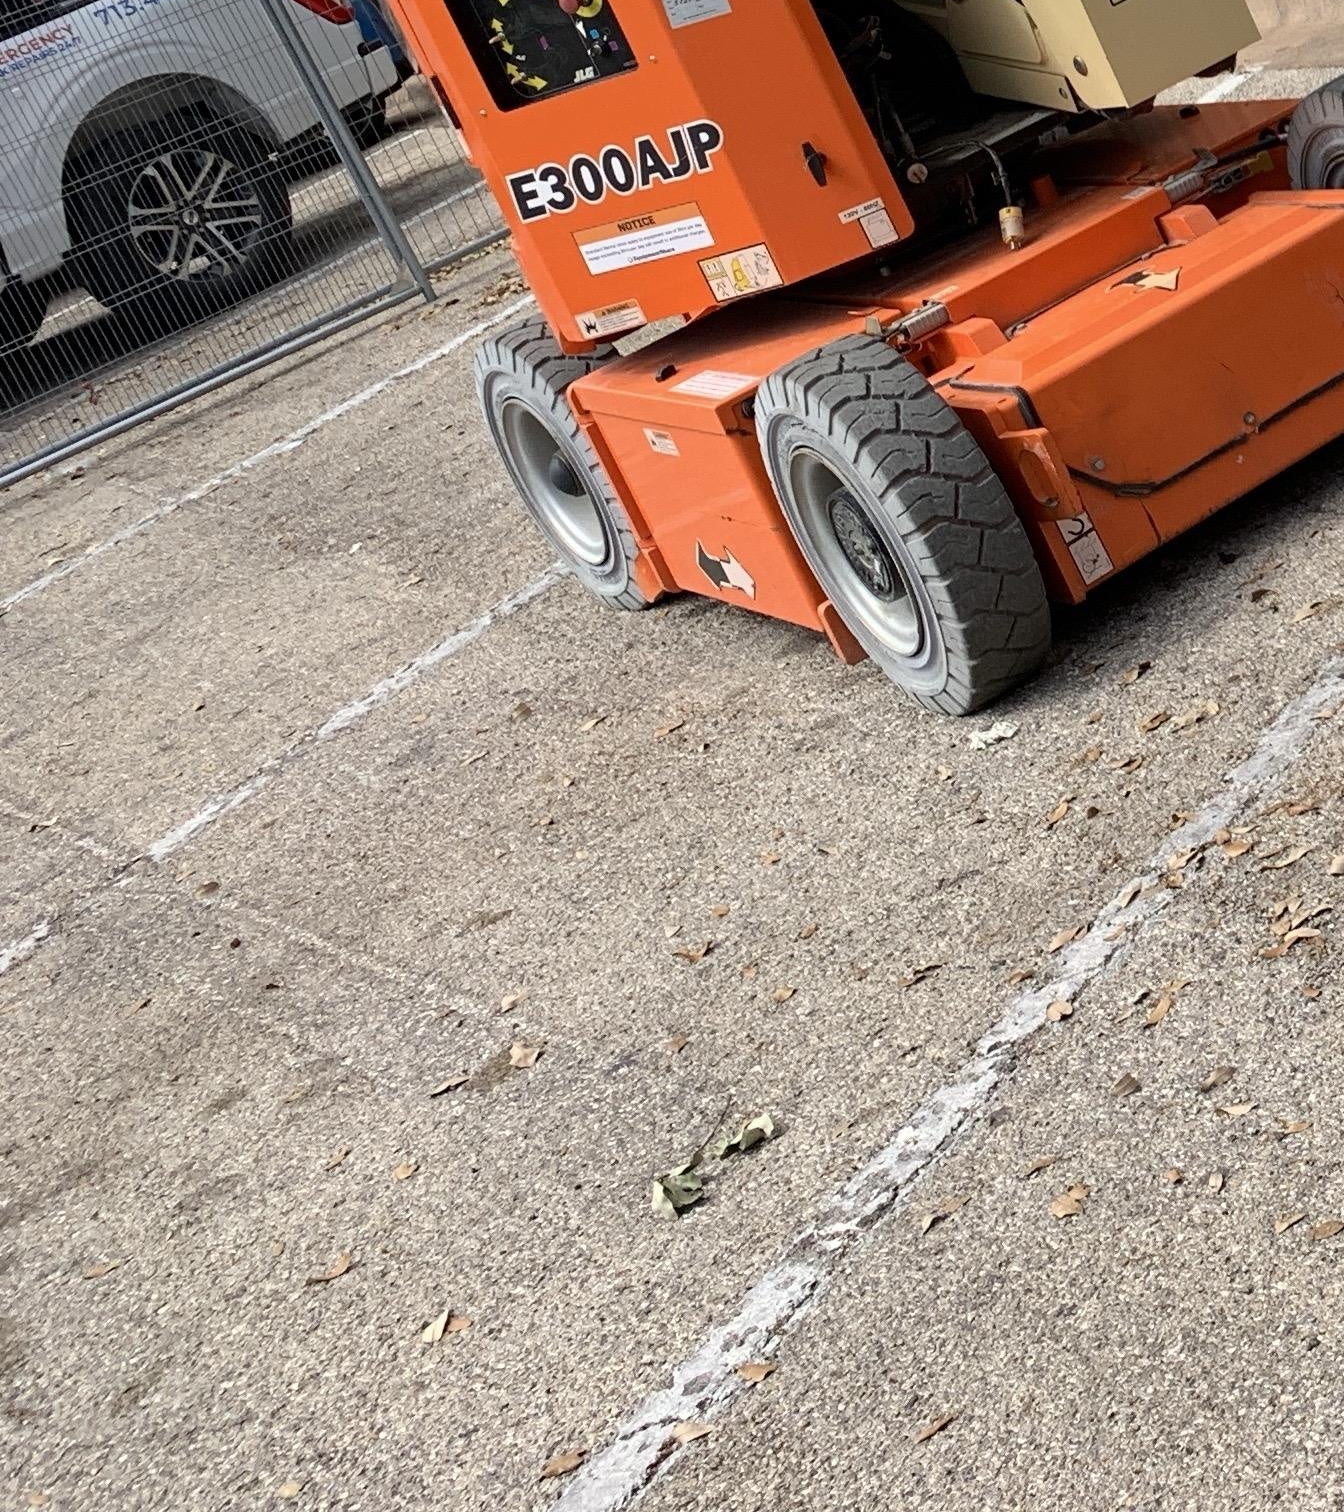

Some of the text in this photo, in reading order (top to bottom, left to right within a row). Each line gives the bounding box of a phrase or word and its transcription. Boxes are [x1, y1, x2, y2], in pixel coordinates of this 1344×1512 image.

[573, 66, 595, 83] JLG
[506, 120, 723, 222] E300AJP
[617, 215, 656, 232] NOTICE
